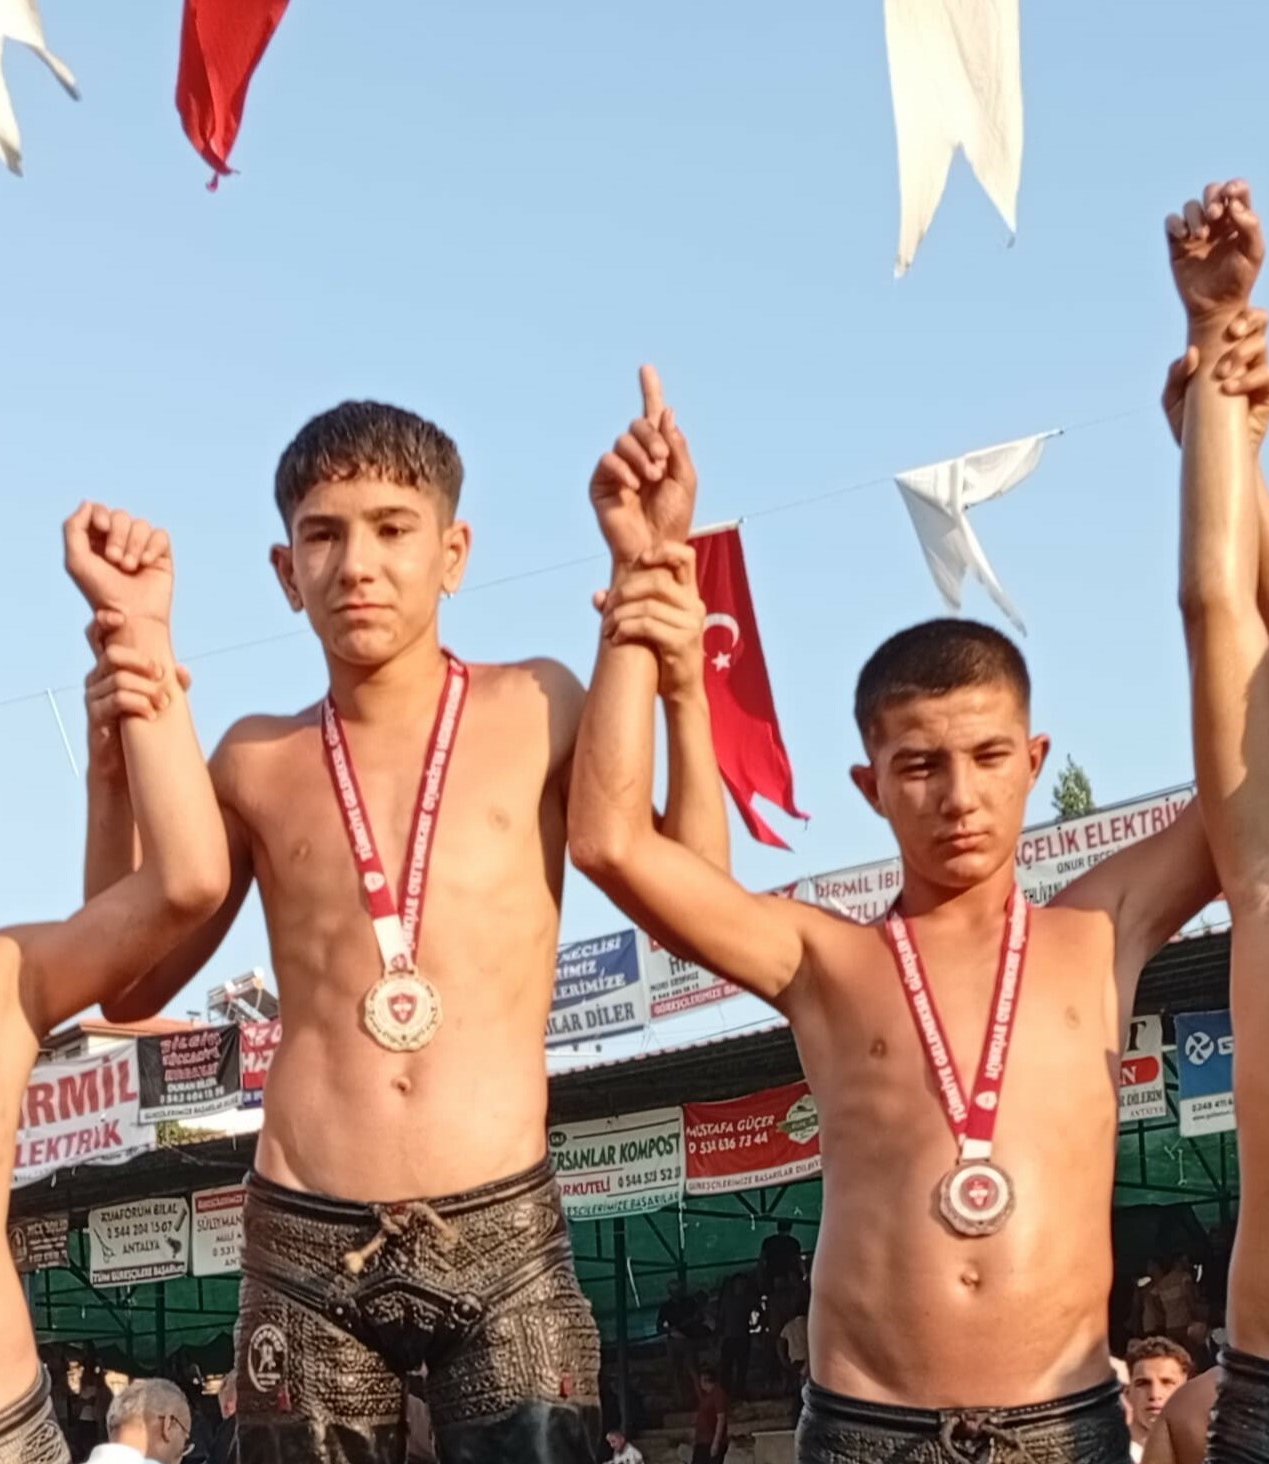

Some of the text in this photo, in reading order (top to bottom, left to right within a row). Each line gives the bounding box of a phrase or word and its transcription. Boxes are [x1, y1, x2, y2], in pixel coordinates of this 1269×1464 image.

[585, 1002, 635, 1028] DİLER
[737, 1115, 775, 1133] GÜÇER
[619, 1133, 680, 1163] KOMPOST
